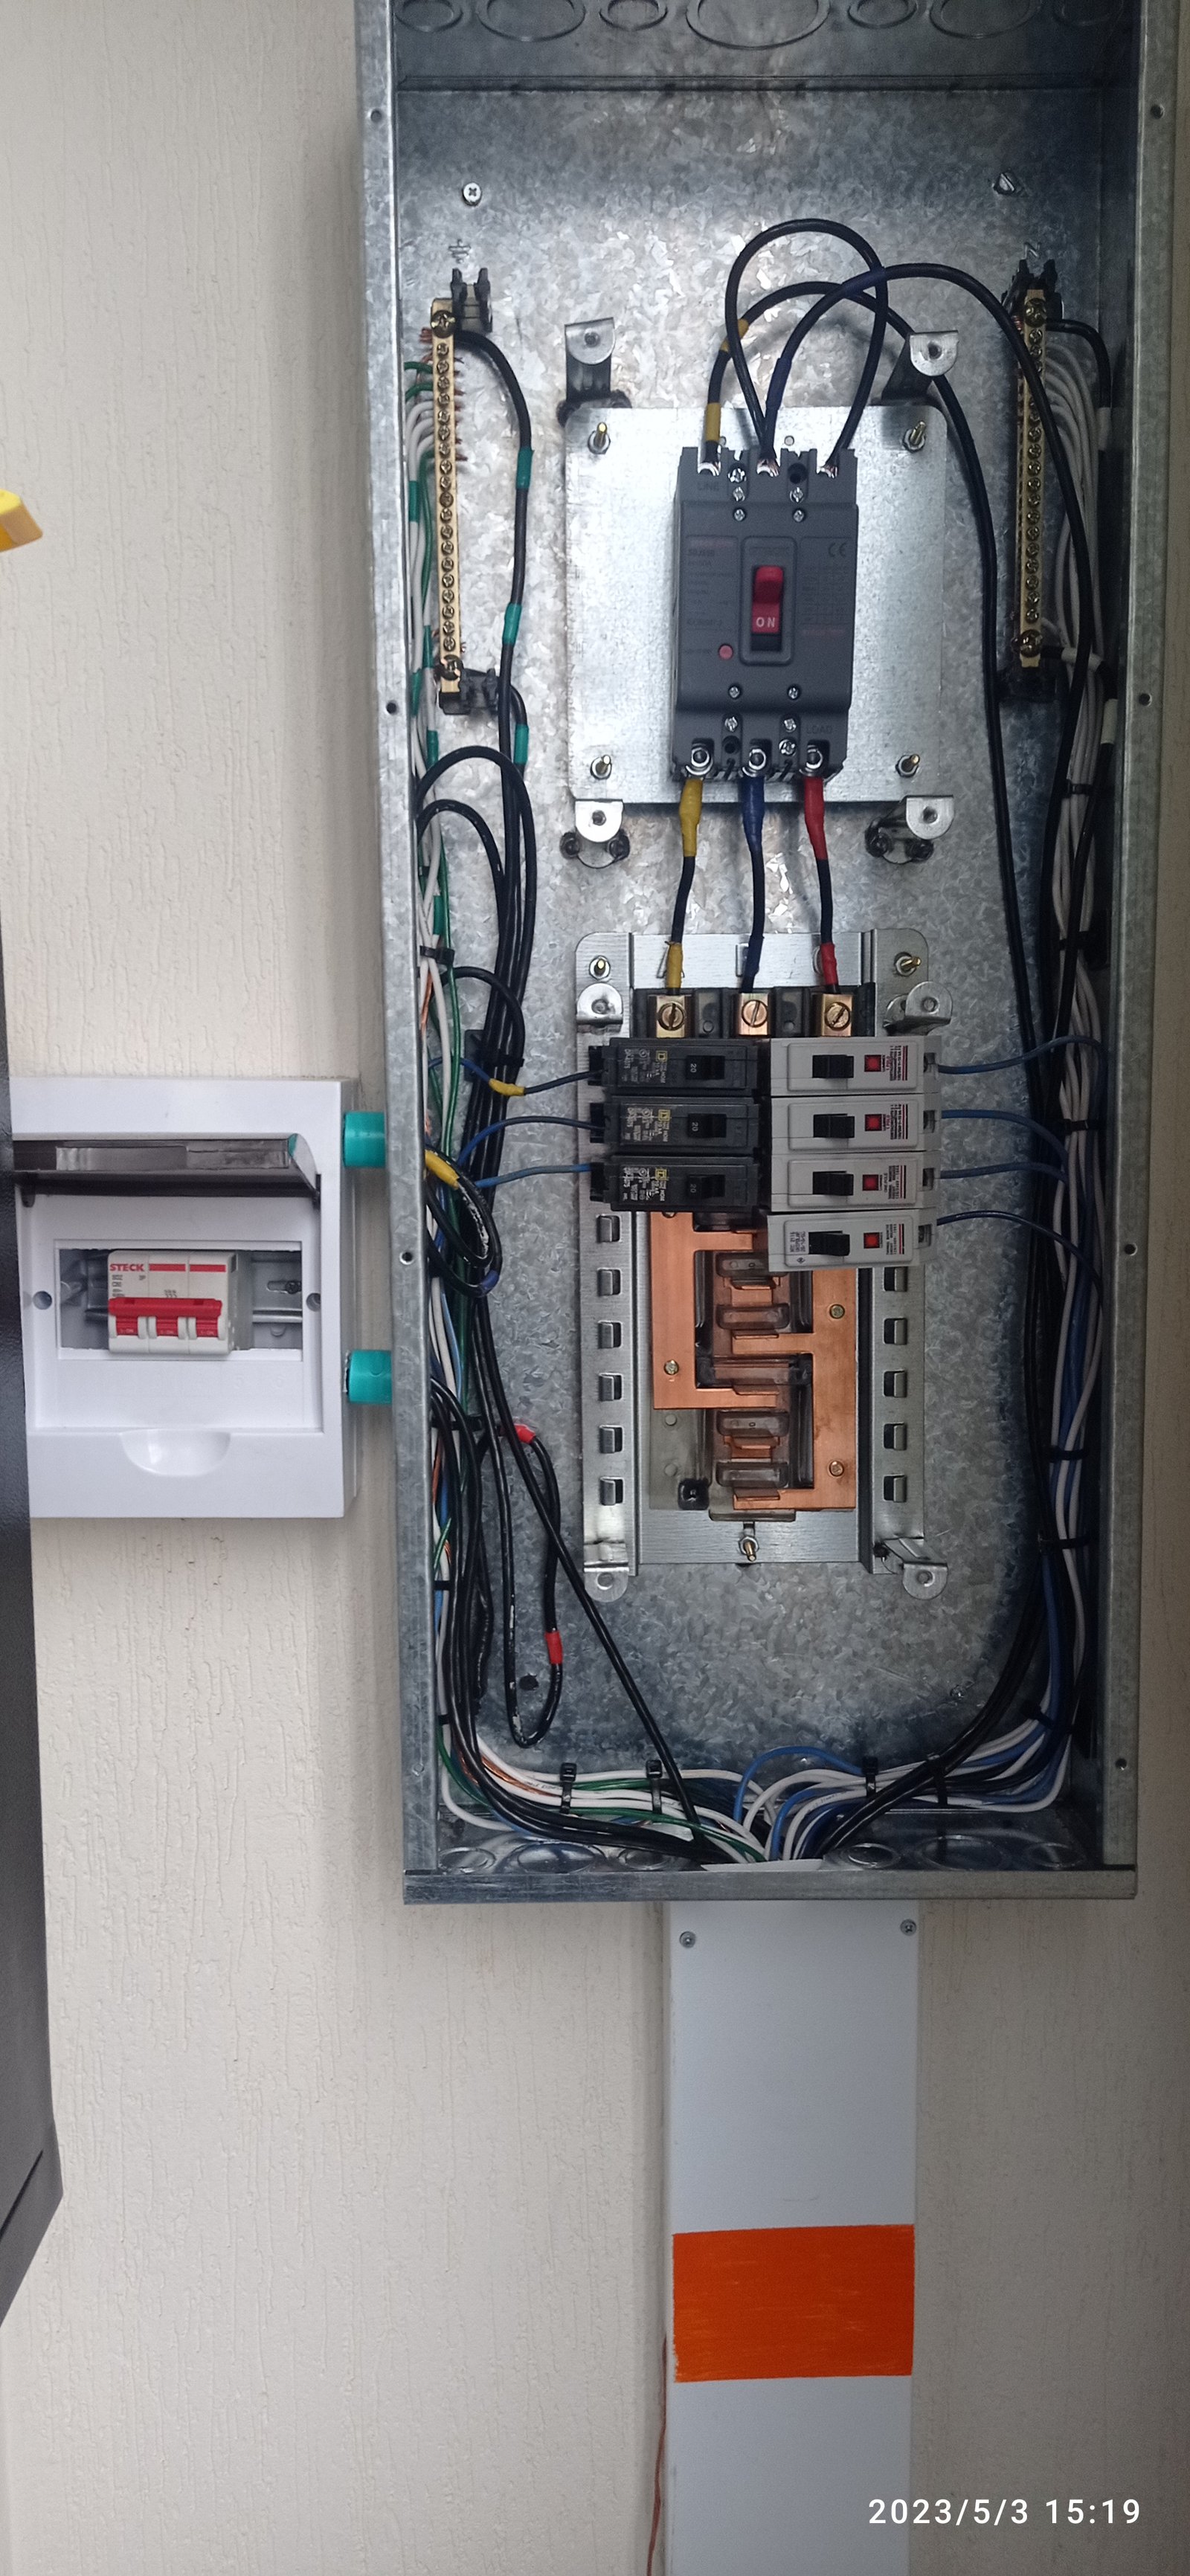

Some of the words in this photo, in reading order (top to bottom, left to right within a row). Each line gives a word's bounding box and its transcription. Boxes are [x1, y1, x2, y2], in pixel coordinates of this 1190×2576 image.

[756, 616, 776, 628] ON
[690, 1063, 697, 1073] 20
[692, 1121, 698, 1132] 20
[690, 1182, 697, 1194] 20
[109, 1263, 144, 1272] STECK
